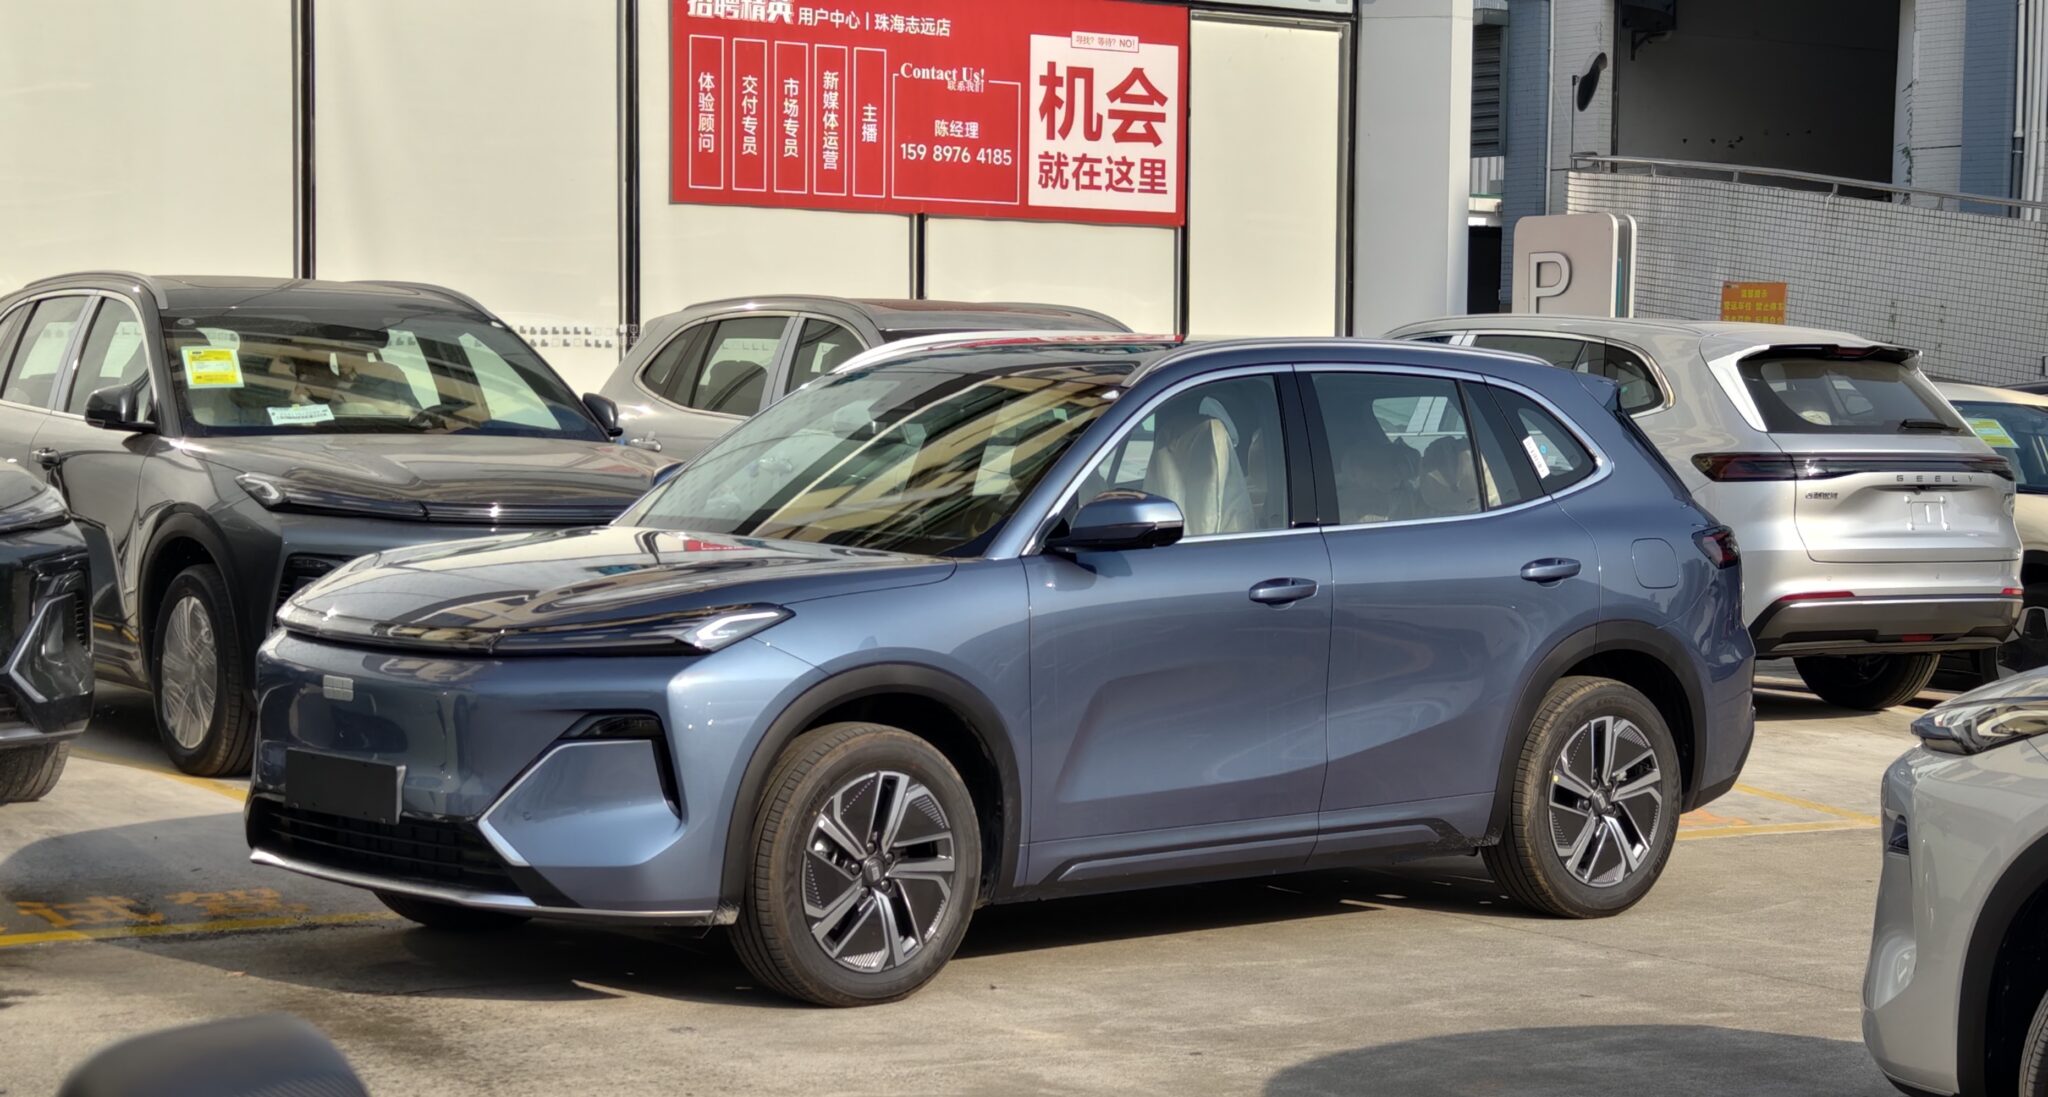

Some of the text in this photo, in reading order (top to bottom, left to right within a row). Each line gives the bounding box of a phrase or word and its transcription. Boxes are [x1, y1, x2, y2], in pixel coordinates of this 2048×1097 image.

[798, 7, 861, 29] 用户中心
[874, 13, 952, 37] 珠海志远店
[1119, 38, 1135, 48] NO!
[900, 63, 985, 83] Contact Us!
[698, 72, 715, 153] 体验顾问
[741, 75, 758, 156] 交付专员
[783, 78, 800, 158] 市场专员
[822, 71, 839, 170] 新媒体运营
[862, 104, 878, 143] 主播
[1038, 61, 1168, 148] 机会
[934, 119, 980, 139] 陈经理
[900, 143, 1012, 166] 159 8976 4185
[1038, 151, 1168, 195] 就在这里
[1528, 251, 1572, 314] P
[1896, 475, 1975, 483] GEELY
